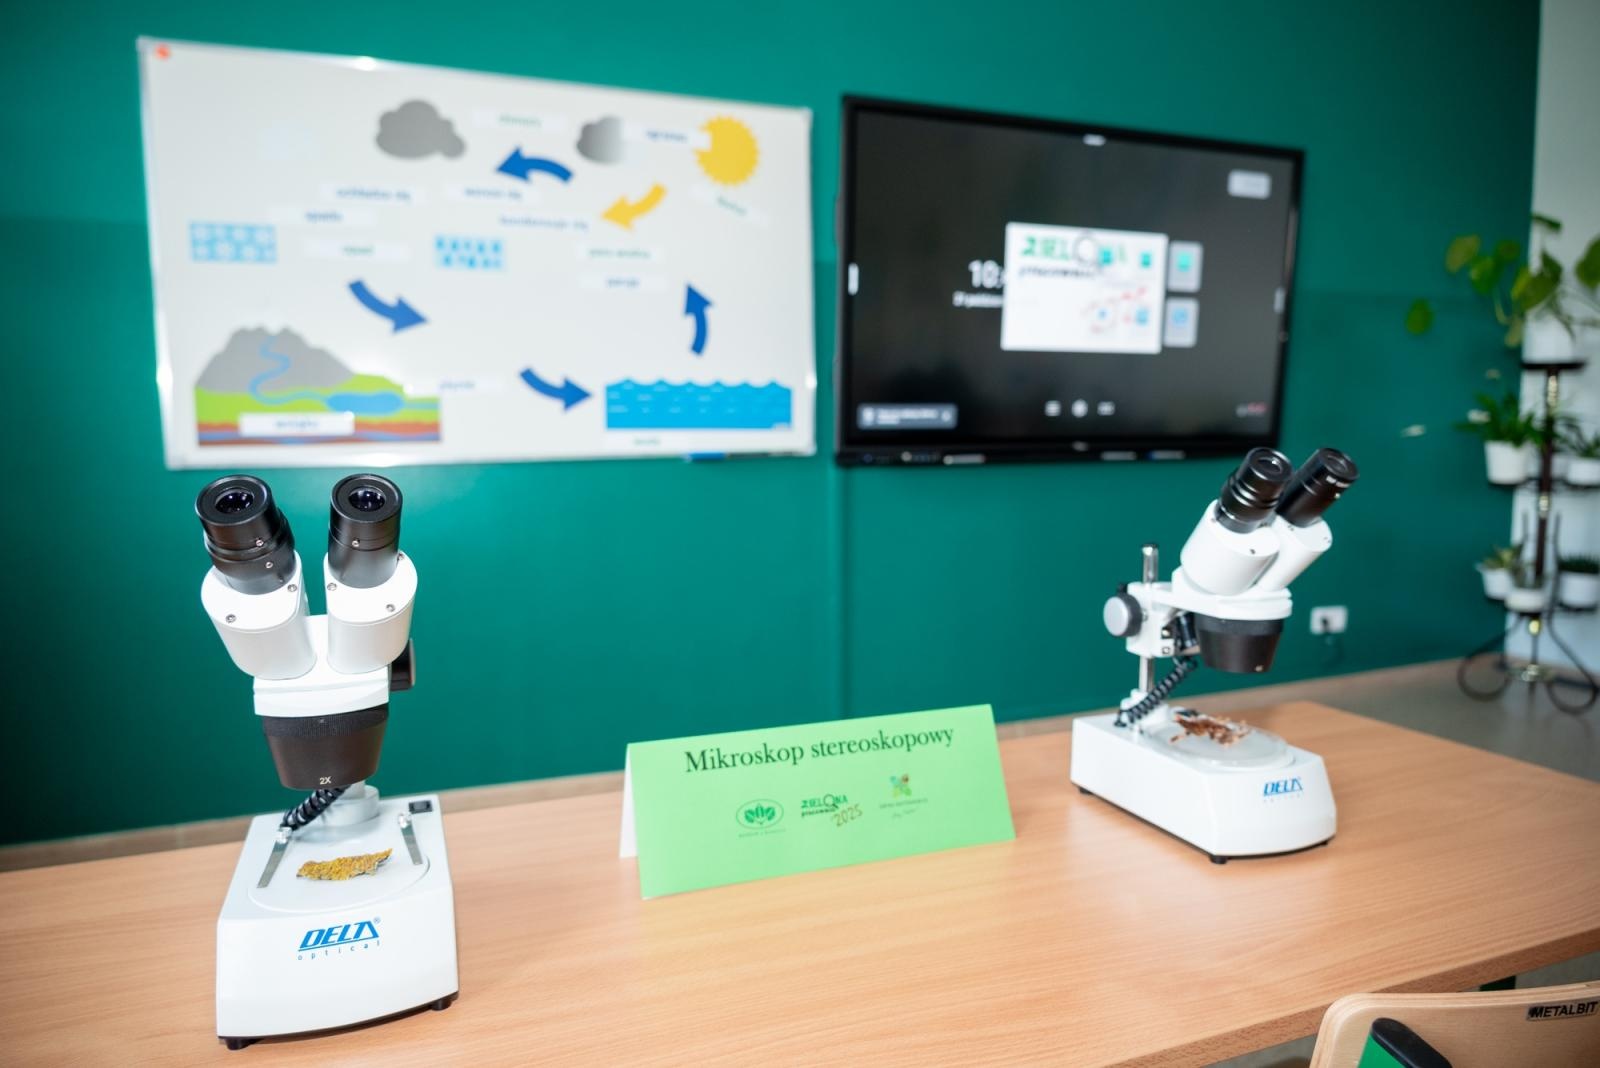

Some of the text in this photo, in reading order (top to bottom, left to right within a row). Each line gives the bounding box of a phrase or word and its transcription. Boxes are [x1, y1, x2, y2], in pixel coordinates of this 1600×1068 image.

[684, 728, 954, 772] Mikroskop stereoskopowy
[320, 776, 332, 785] 2X
[832, 803, 863, 827] 2025
[297, 940, 380, 960] optical
[1529, 1001, 1599, 1017] METALBIT
